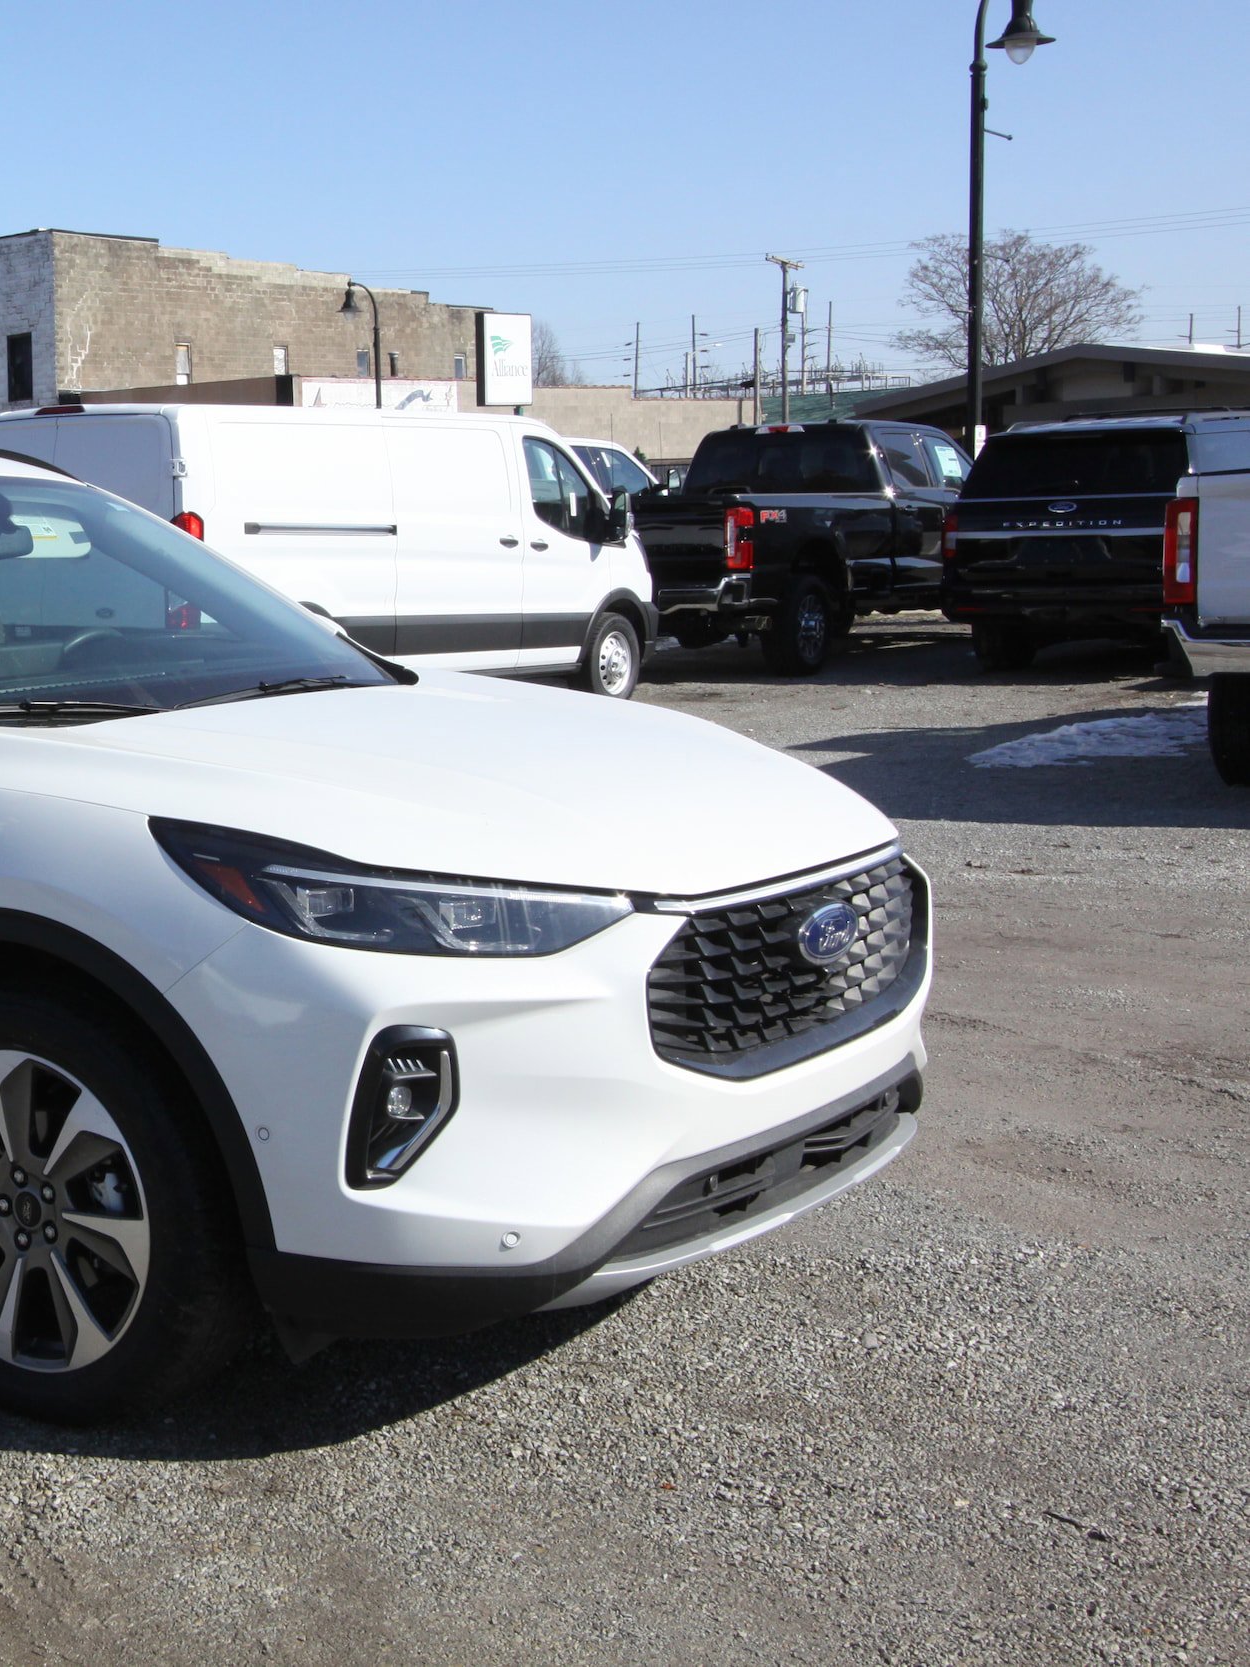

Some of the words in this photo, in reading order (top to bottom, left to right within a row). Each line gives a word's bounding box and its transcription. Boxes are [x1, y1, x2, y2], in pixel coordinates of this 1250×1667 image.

[491, 358, 528, 377] Alliance
[760, 509, 787, 524] FX4
[1002, 519, 1122, 528] EXPEDITION
[818, 914, 850, 951] Ford
